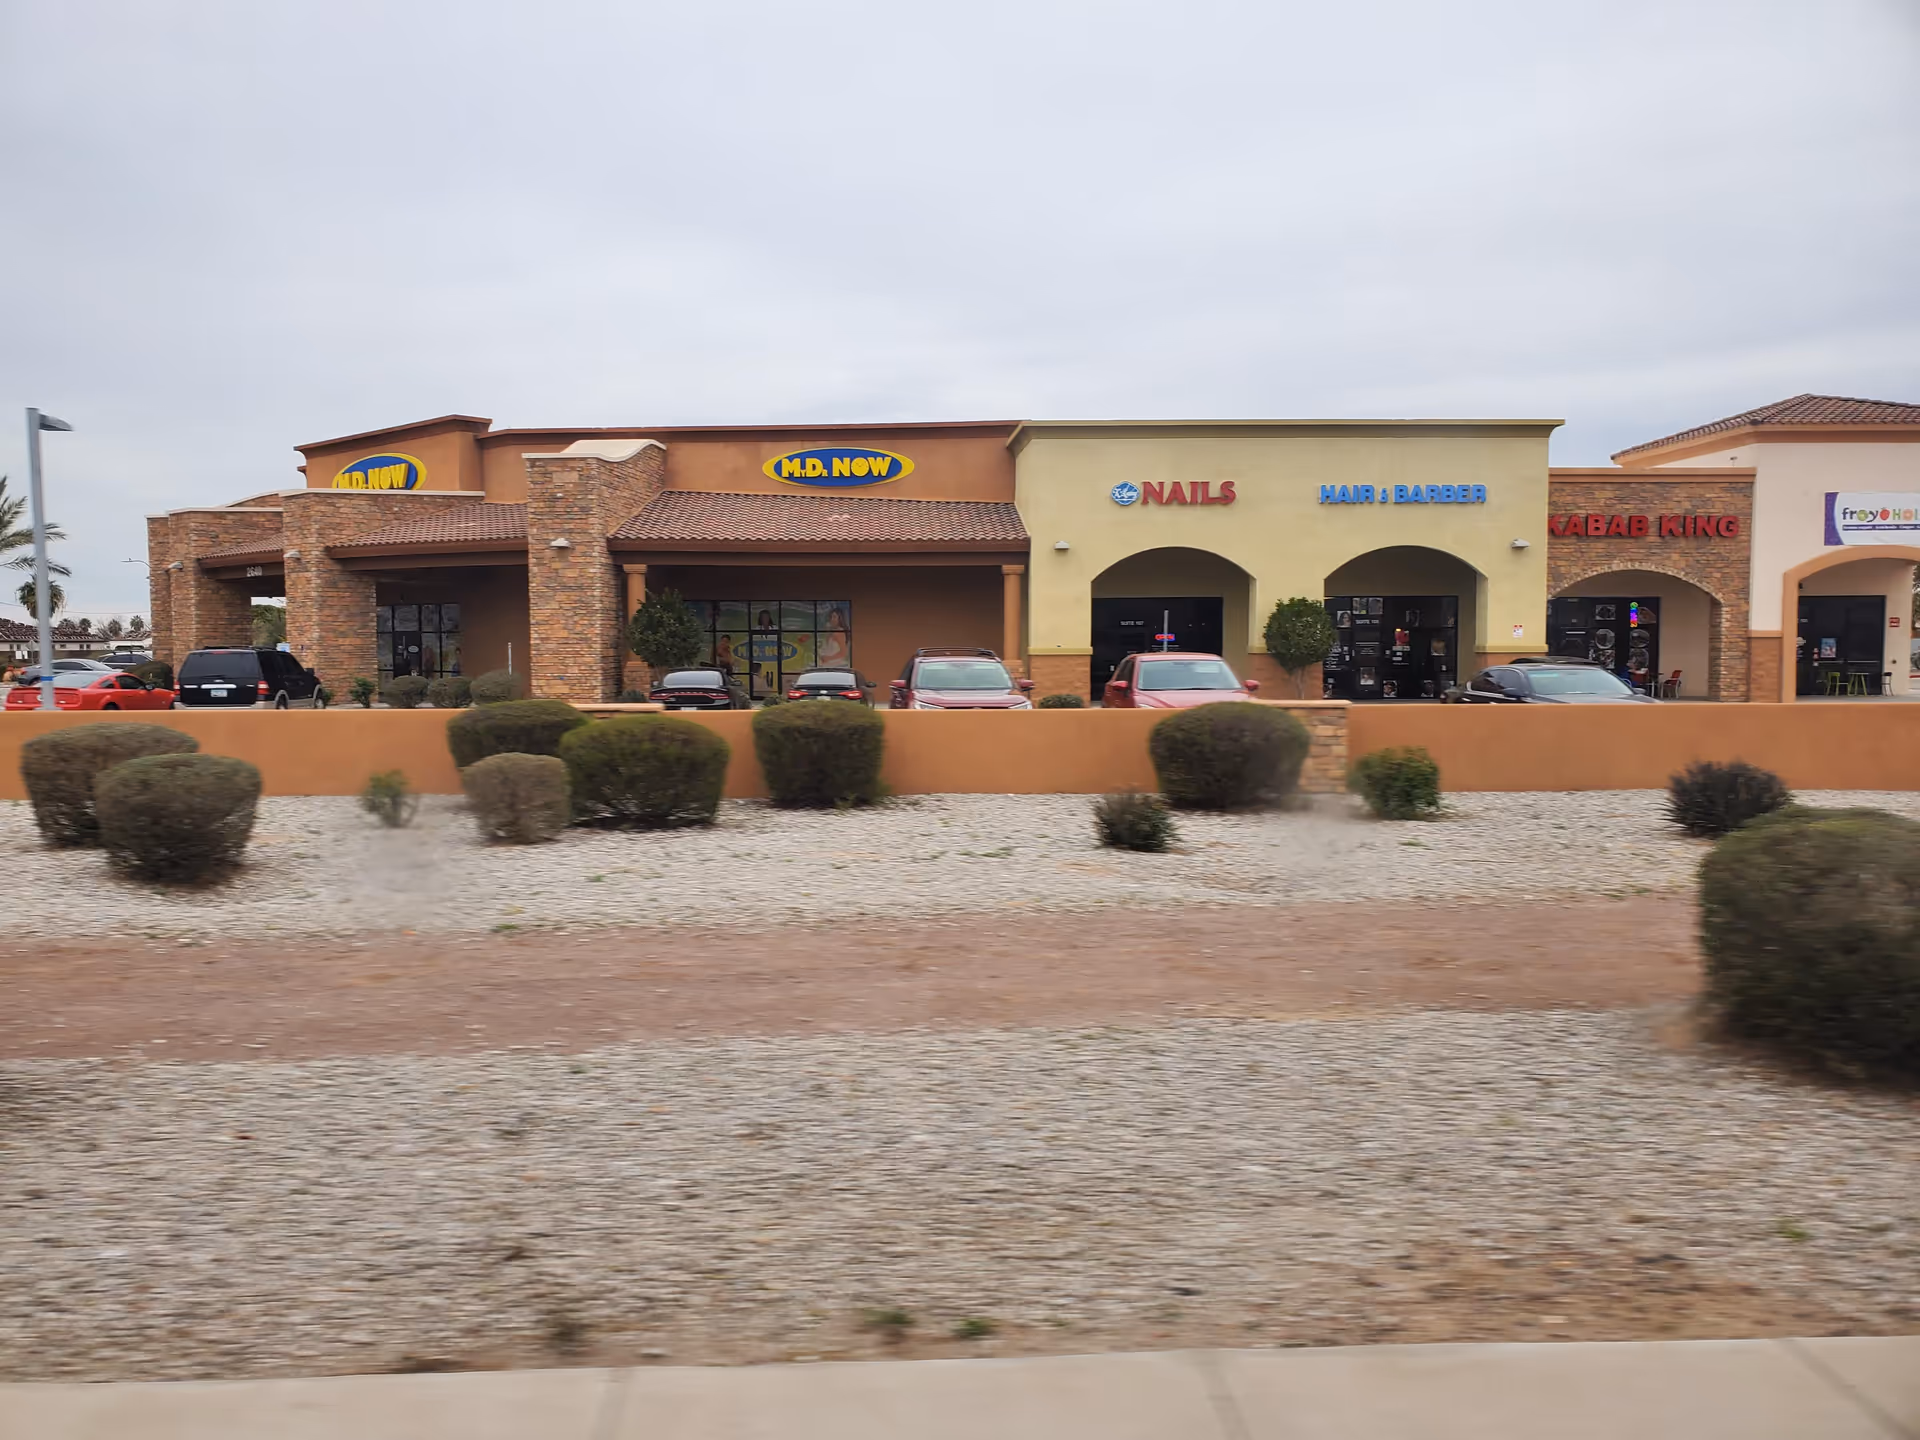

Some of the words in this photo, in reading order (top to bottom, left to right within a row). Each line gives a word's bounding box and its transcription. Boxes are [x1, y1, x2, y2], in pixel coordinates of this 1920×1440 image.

[368, 463, 409, 489] NOW
[832, 456, 892, 477] NOW
[1141, 480, 1236, 505] NAILS
[1320, 485, 1375, 503] HAIR
[1379, 488, 1388, 503] &
[1394, 485, 1486, 503] BARBER
[1548, 514, 1649, 537] KABAB
[1659, 514, 1739, 537] KING
